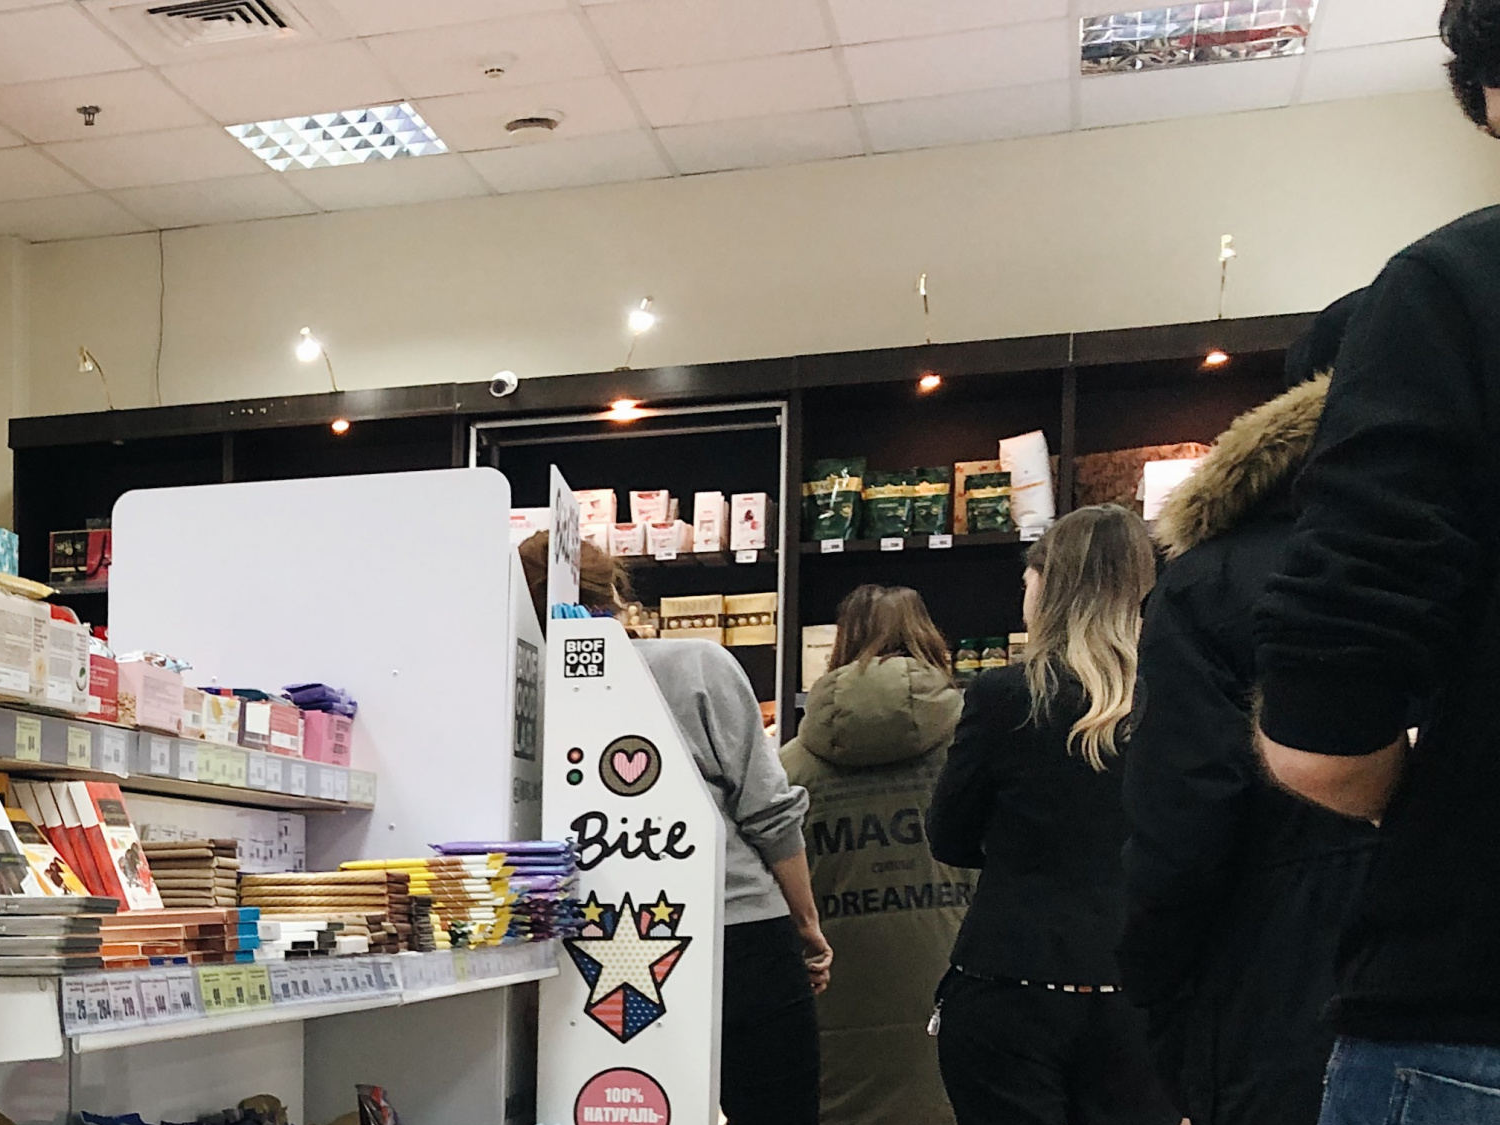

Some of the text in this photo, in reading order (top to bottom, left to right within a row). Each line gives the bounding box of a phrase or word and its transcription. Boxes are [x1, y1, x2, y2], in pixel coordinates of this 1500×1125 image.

[565, 639, 604, 652] BIOF
[565, 652, 604, 665] OOD
[565, 664, 604, 677] LAB.
[571, 811, 696, 871] Bite
[604, 1087, 645, 1104] 100%
[583, 1106, 664, 1124] НАТУРАЛЬ-
